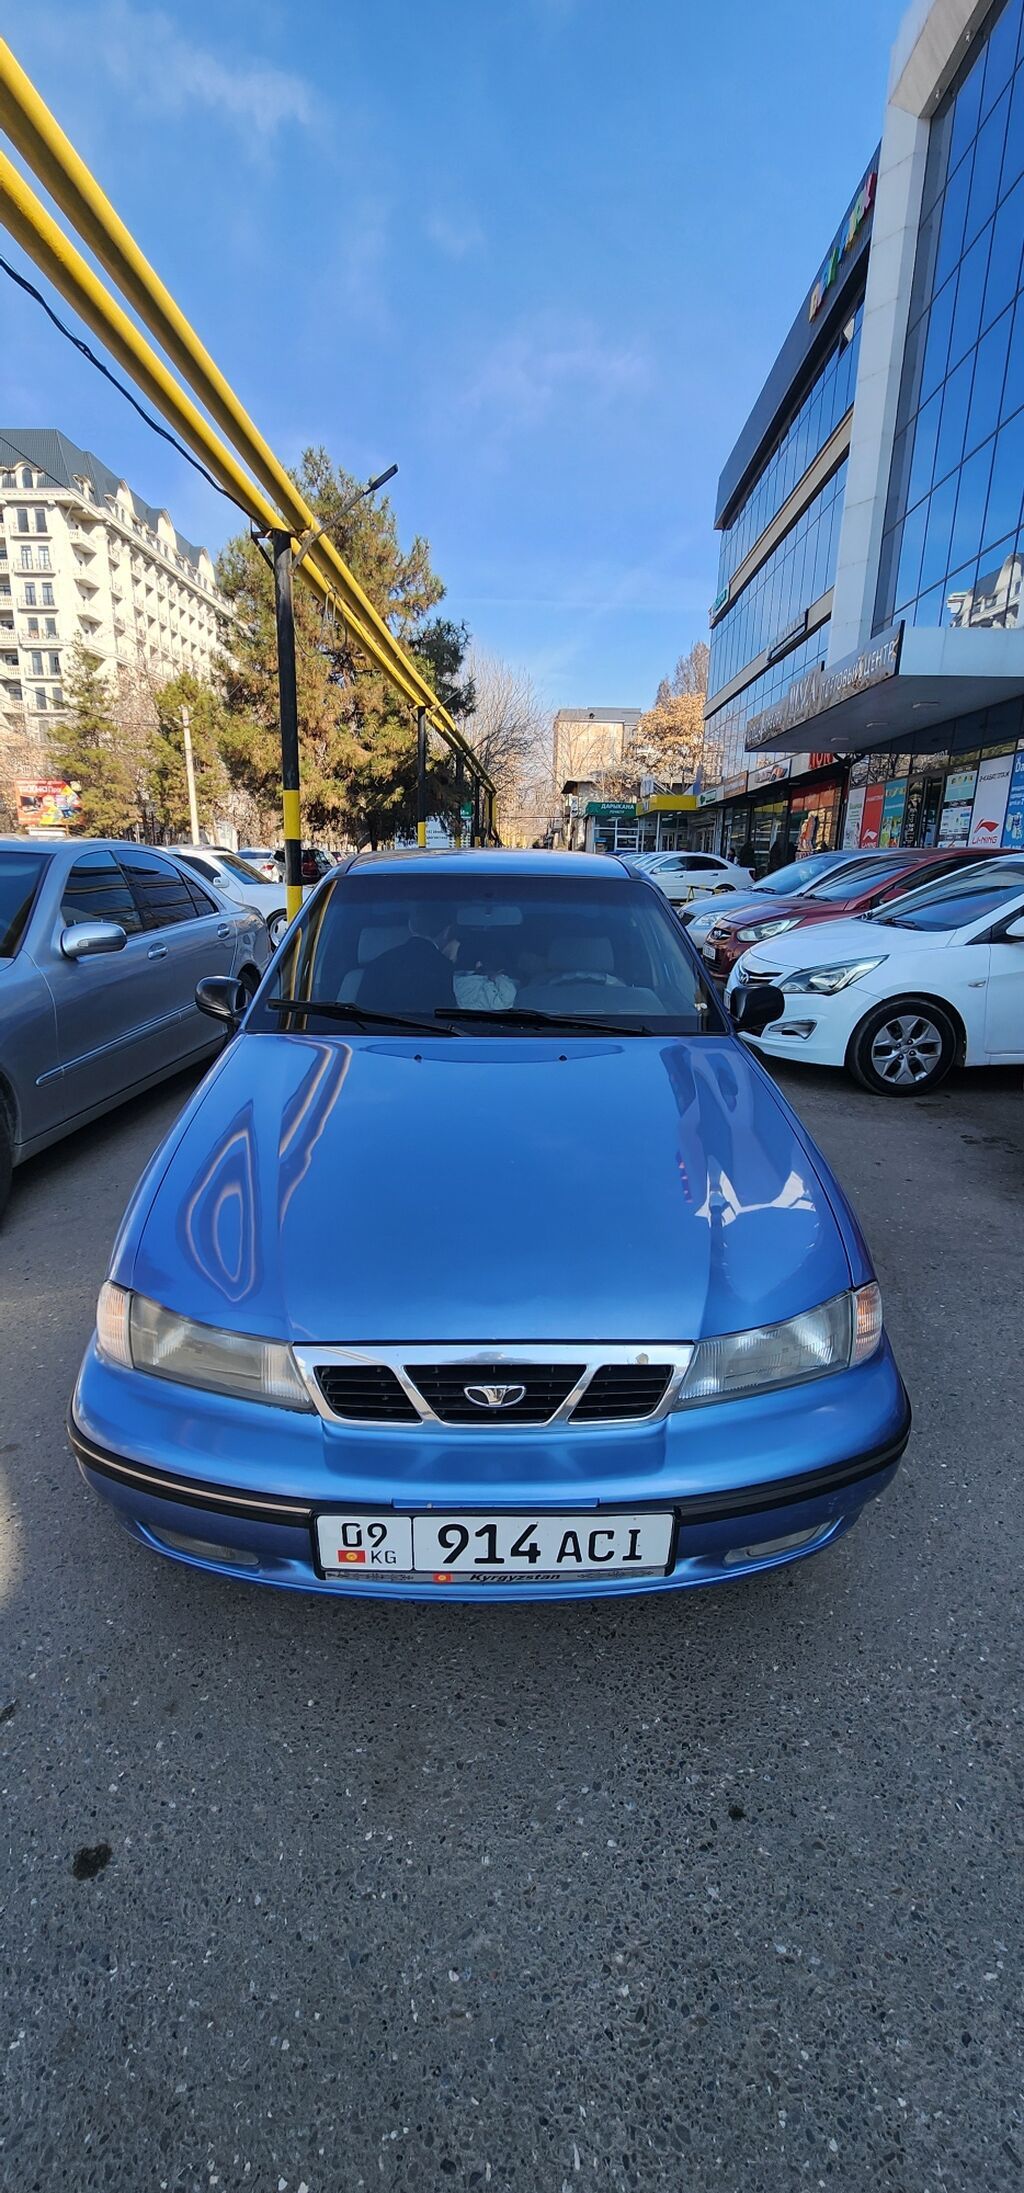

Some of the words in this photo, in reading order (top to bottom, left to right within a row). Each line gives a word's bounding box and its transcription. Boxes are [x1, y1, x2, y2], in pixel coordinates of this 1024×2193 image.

[341, 1522, 388, 1548] 09
[437, 1523, 541, 1564] 914
[556, 1528, 643, 1563] ACI
[370, 1550, 397, 1564] KG
[469, 1573, 561, 1583] Kyrgyzstan
